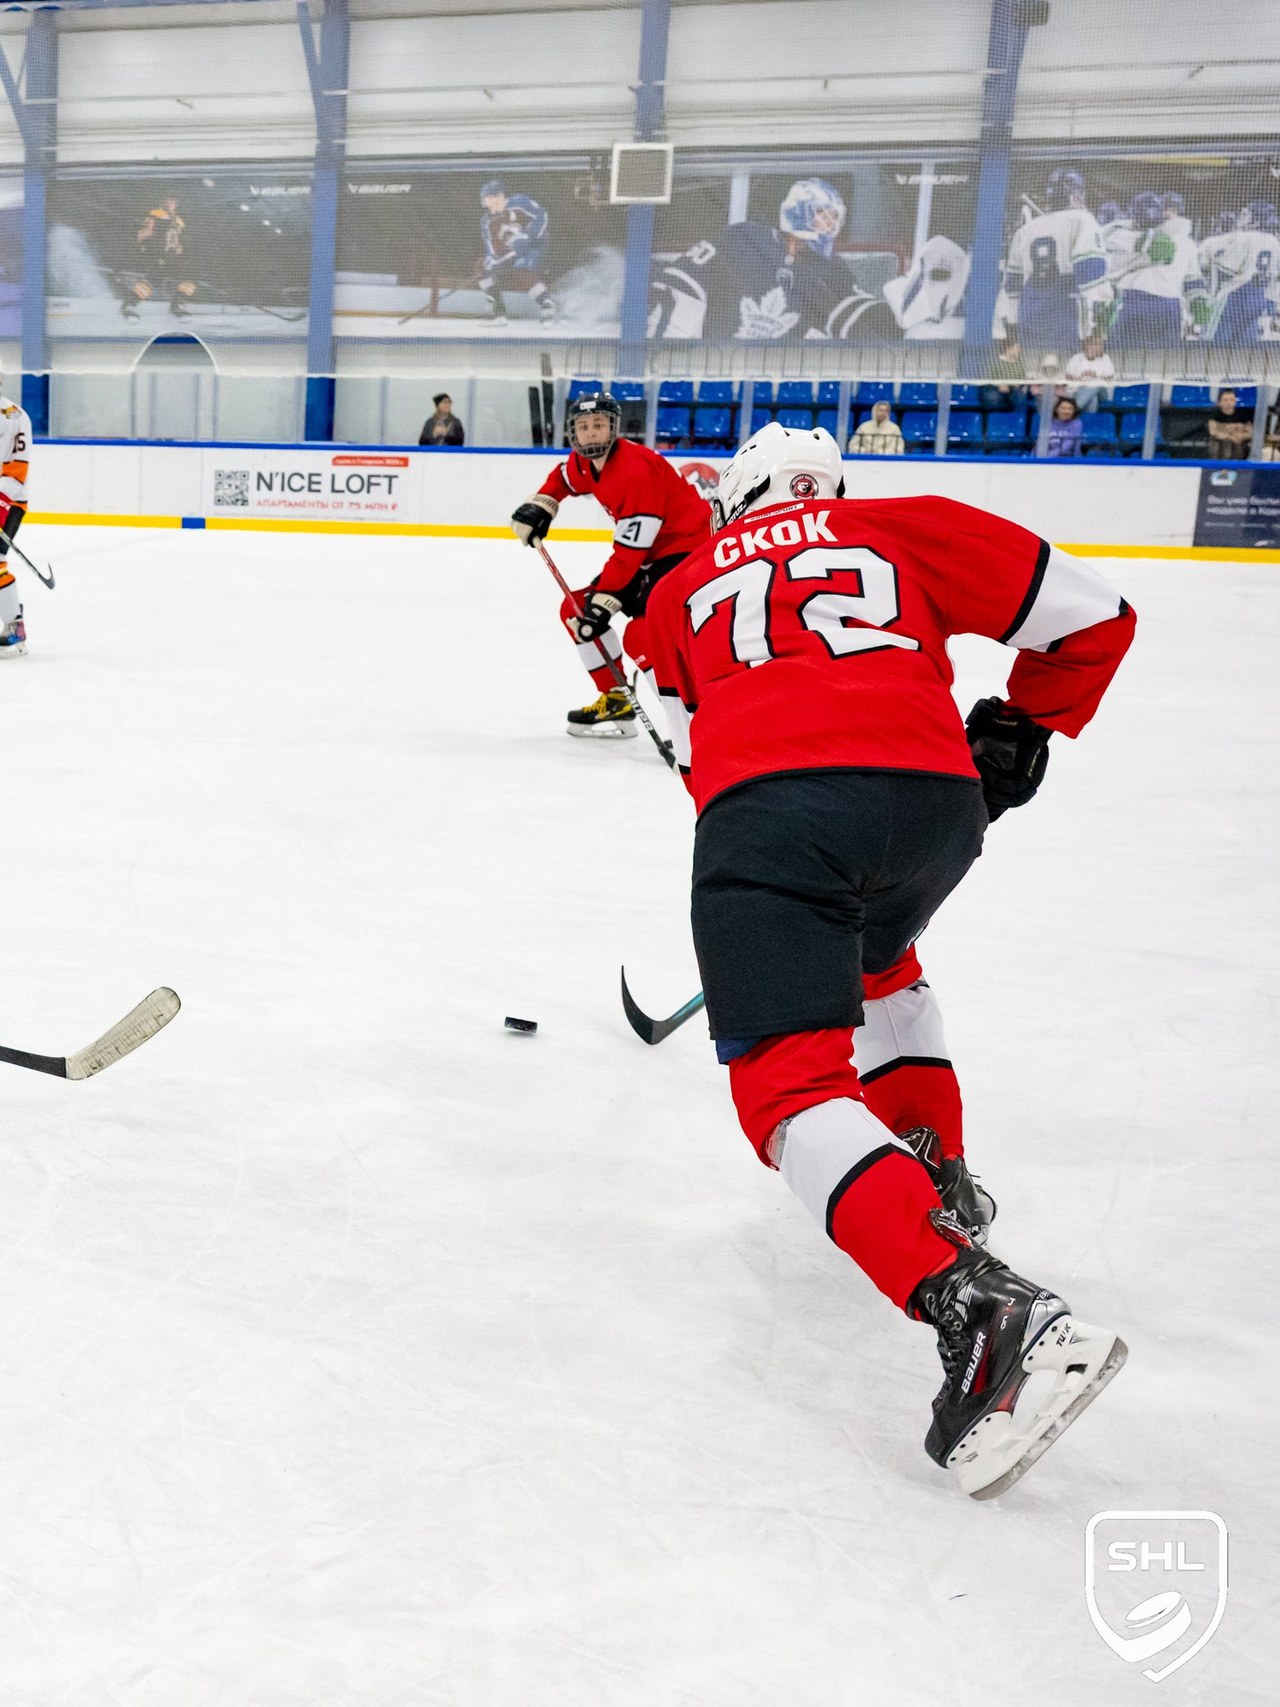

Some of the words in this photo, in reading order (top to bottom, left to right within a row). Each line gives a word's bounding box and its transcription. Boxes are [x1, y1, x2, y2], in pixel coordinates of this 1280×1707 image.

[331, 473, 398, 494] LOFT
[713, 510, 838, 568] СКОК
[684, 544, 922, 669] 72
[962, 1331, 987, 1394] BAUER
